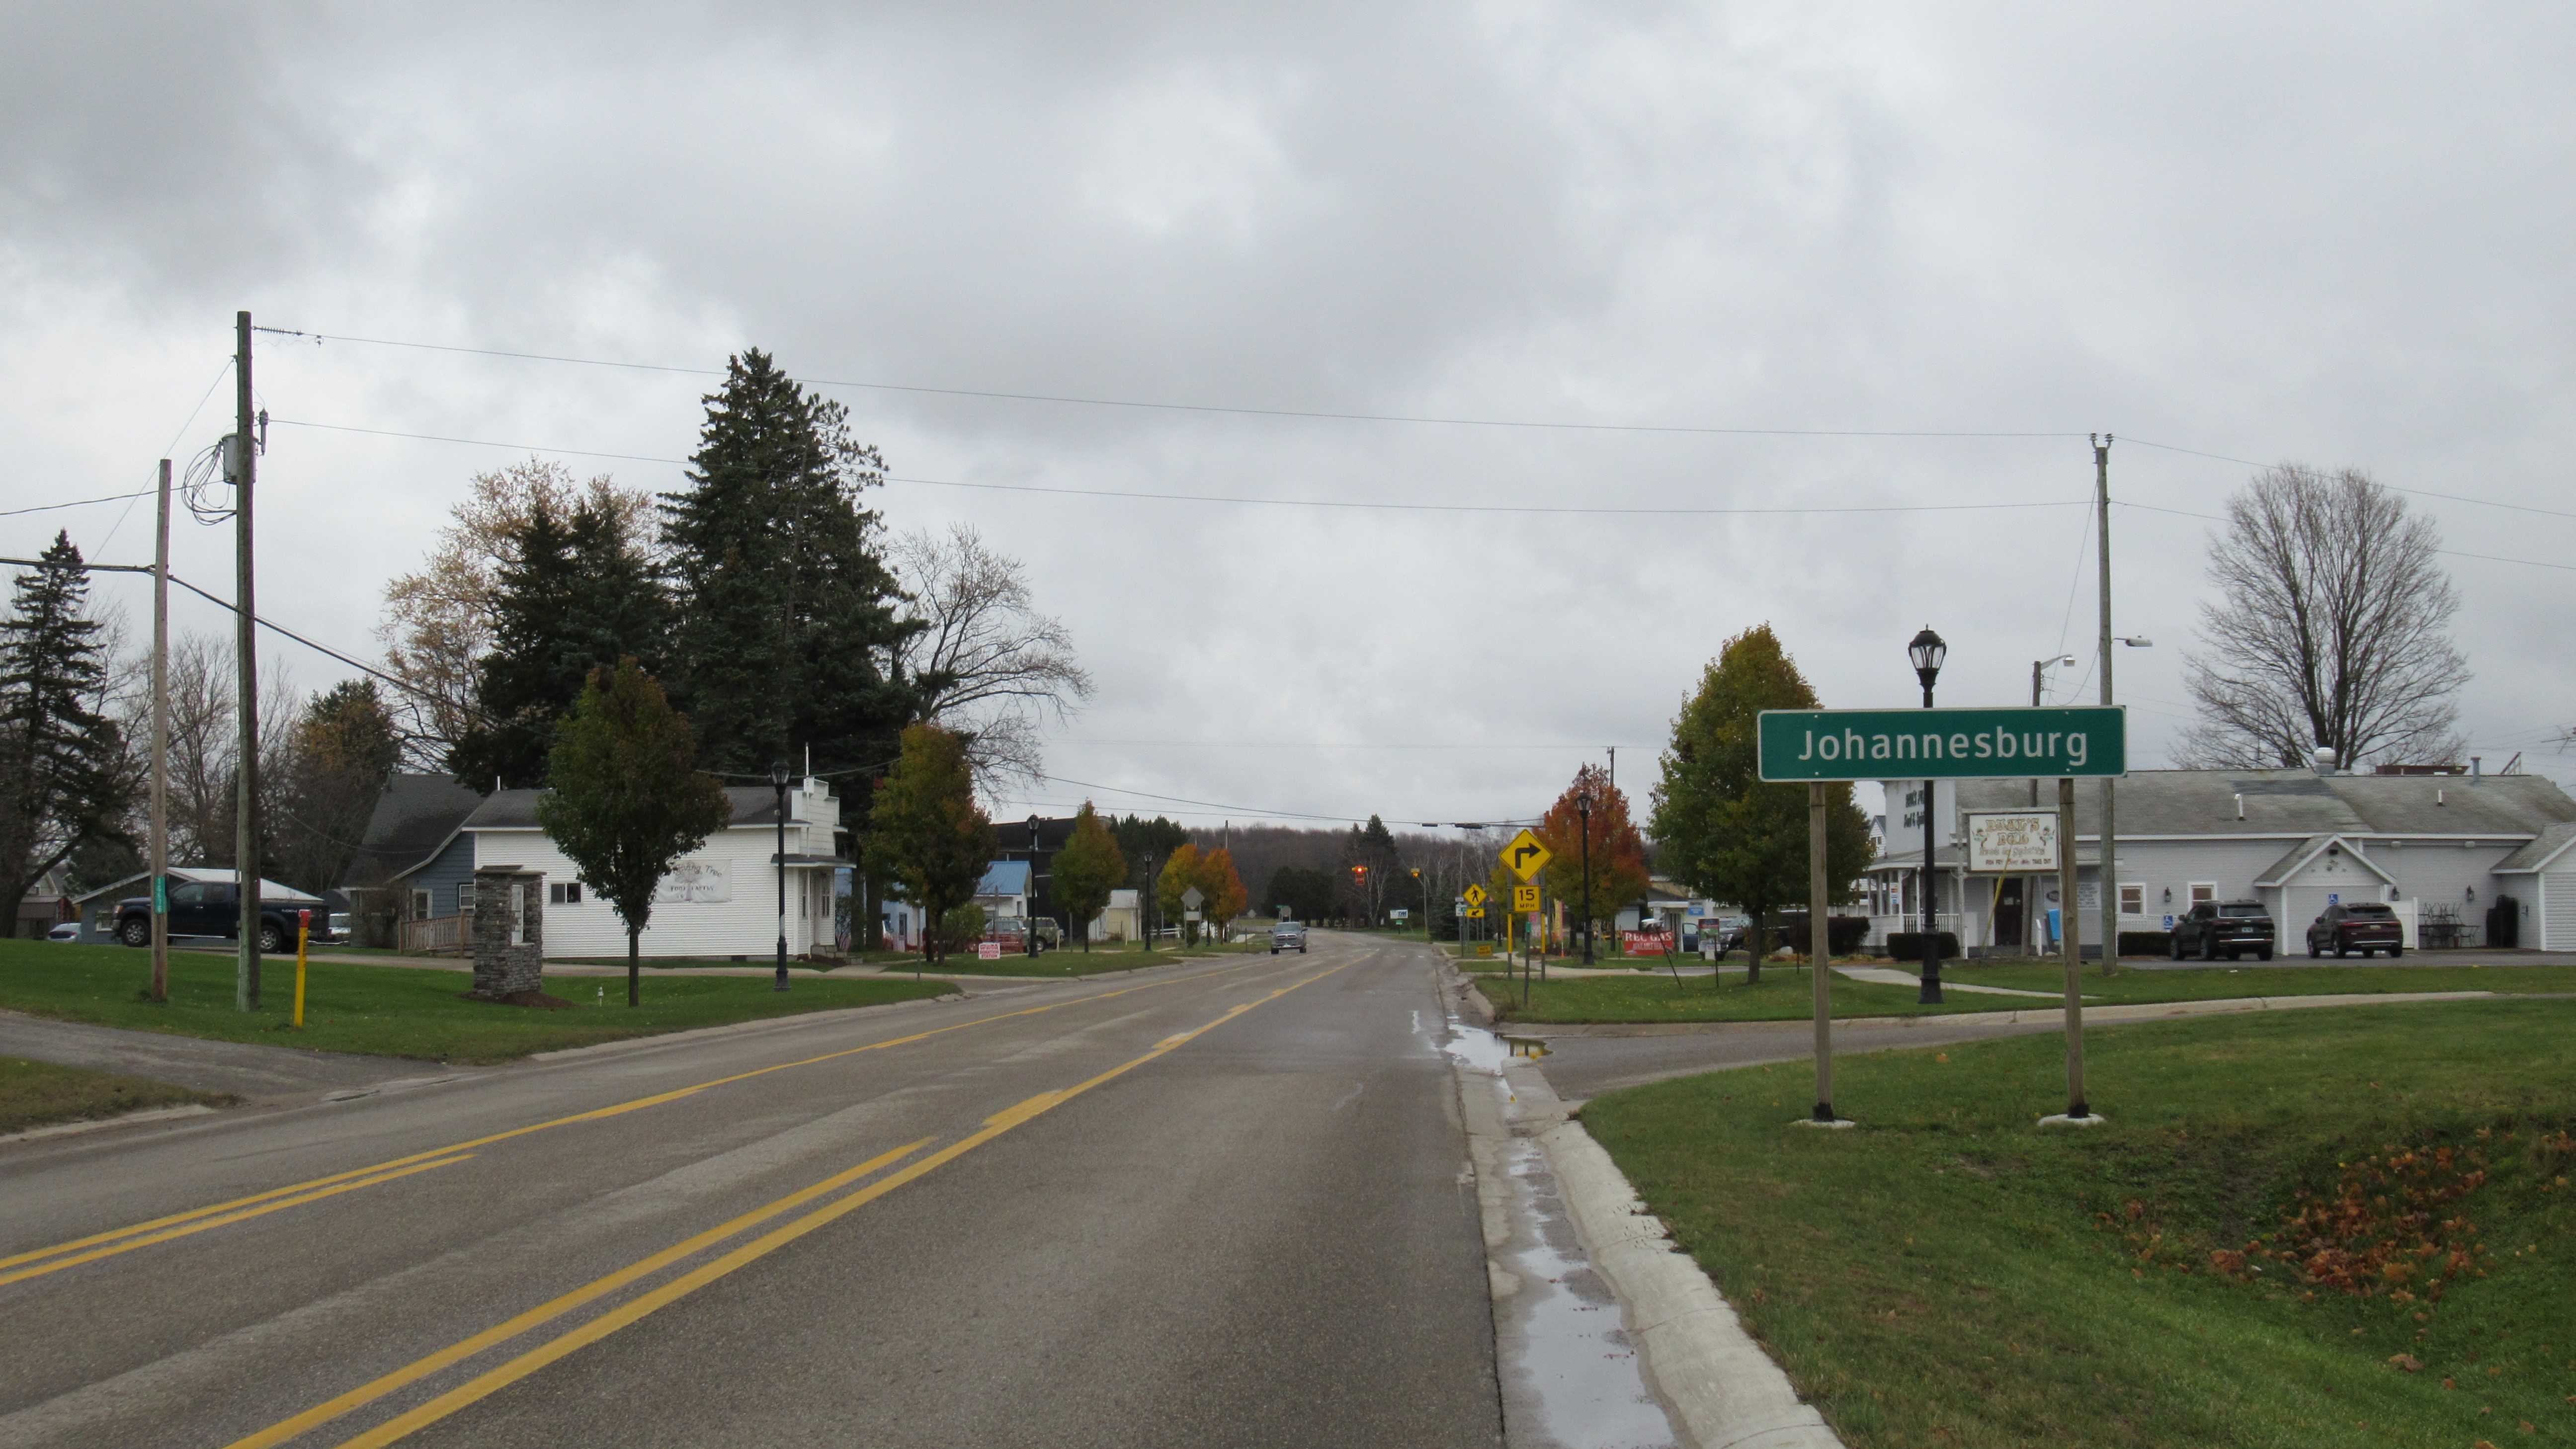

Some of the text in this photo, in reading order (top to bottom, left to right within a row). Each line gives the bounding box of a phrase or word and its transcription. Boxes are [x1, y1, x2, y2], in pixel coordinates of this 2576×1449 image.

[1798, 725, 2087, 766] Johannesburg
[706, 865, 723, 878] Tree
[1519, 889, 1535, 901] 15
[1625, 932, 1672, 942] REC GAS
